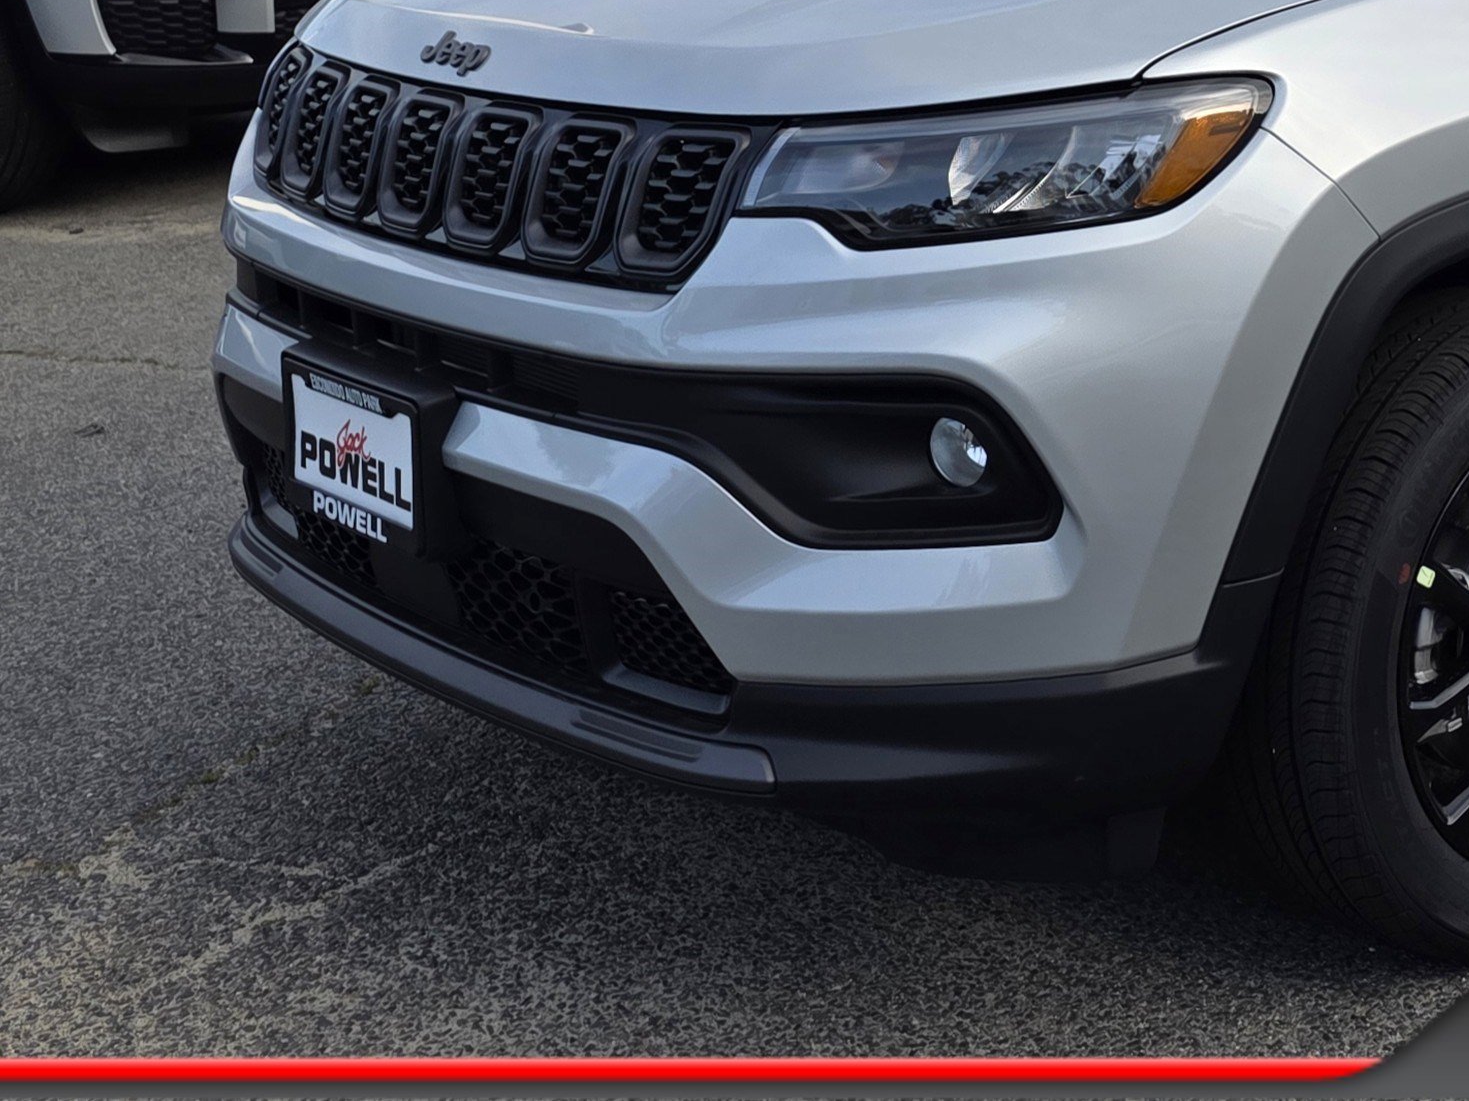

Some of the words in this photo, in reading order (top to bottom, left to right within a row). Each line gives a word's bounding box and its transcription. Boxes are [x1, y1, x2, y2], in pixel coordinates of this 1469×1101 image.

[420, 30, 492, 77] Jeep
[337, 419, 371, 468] Jack
[301, 430, 411, 512] POWELL
[313, 490, 388, 544] POWELL
